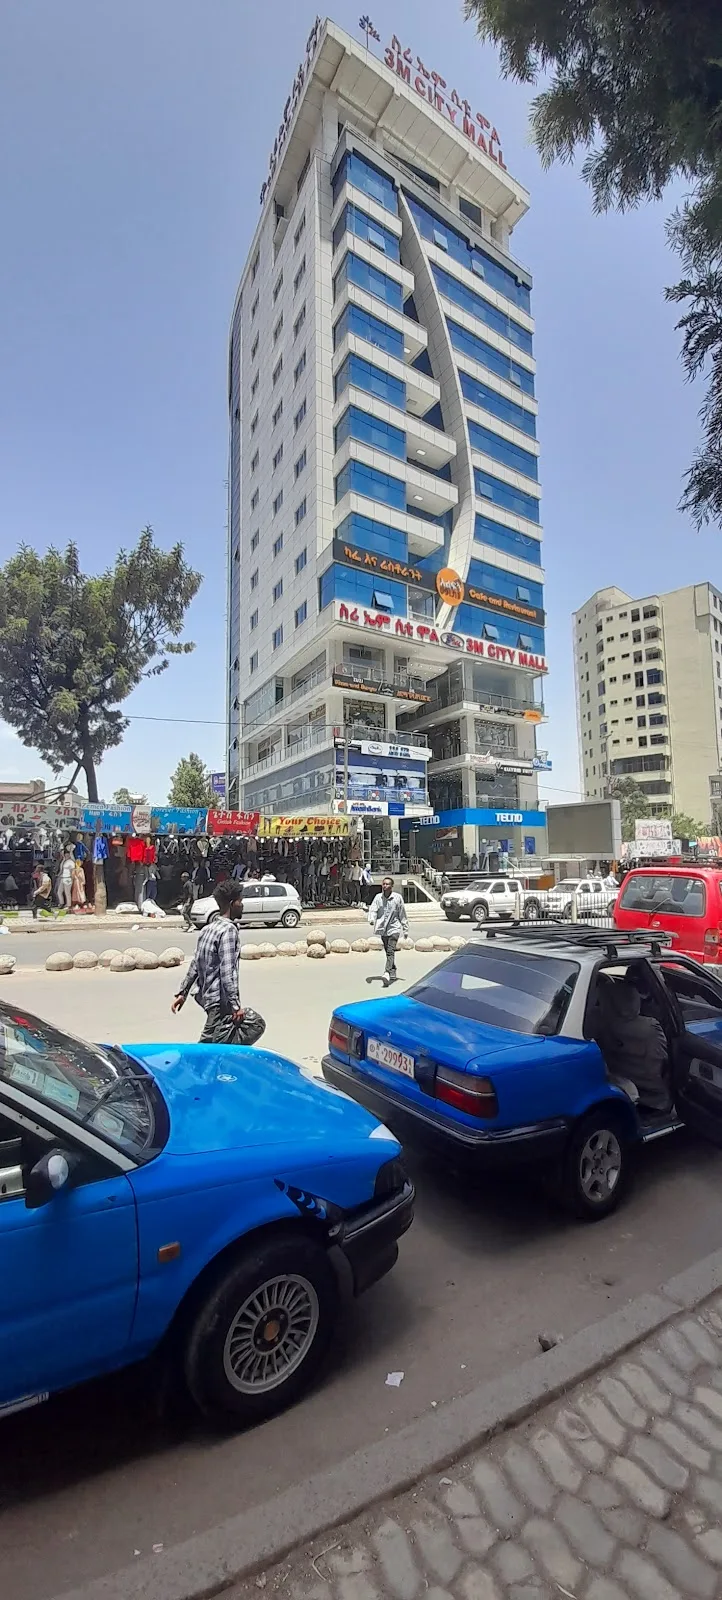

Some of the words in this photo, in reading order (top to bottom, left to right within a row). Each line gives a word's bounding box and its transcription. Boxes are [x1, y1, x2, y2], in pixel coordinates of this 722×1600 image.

[384, 48, 411, 84] 3M
[415, 76, 457, 123] CITY
[463, 117, 507, 170] MALL
[469, 589, 487, 602] Cafe
[488, 596, 503, 606] and
[503, 600, 536, 619] Restaurant
[466, 638, 484, 656] 3M
[487, 644, 516, 663] CITY
[518, 652, 548, 671] MALL
[105, 804, 131, 812] Fashion
[279, 816, 303, 825] Your
[306, 816, 341, 825] Choice
[419, 815, 440, 826] TECNO
[495, 813, 523, 823] TECNO
